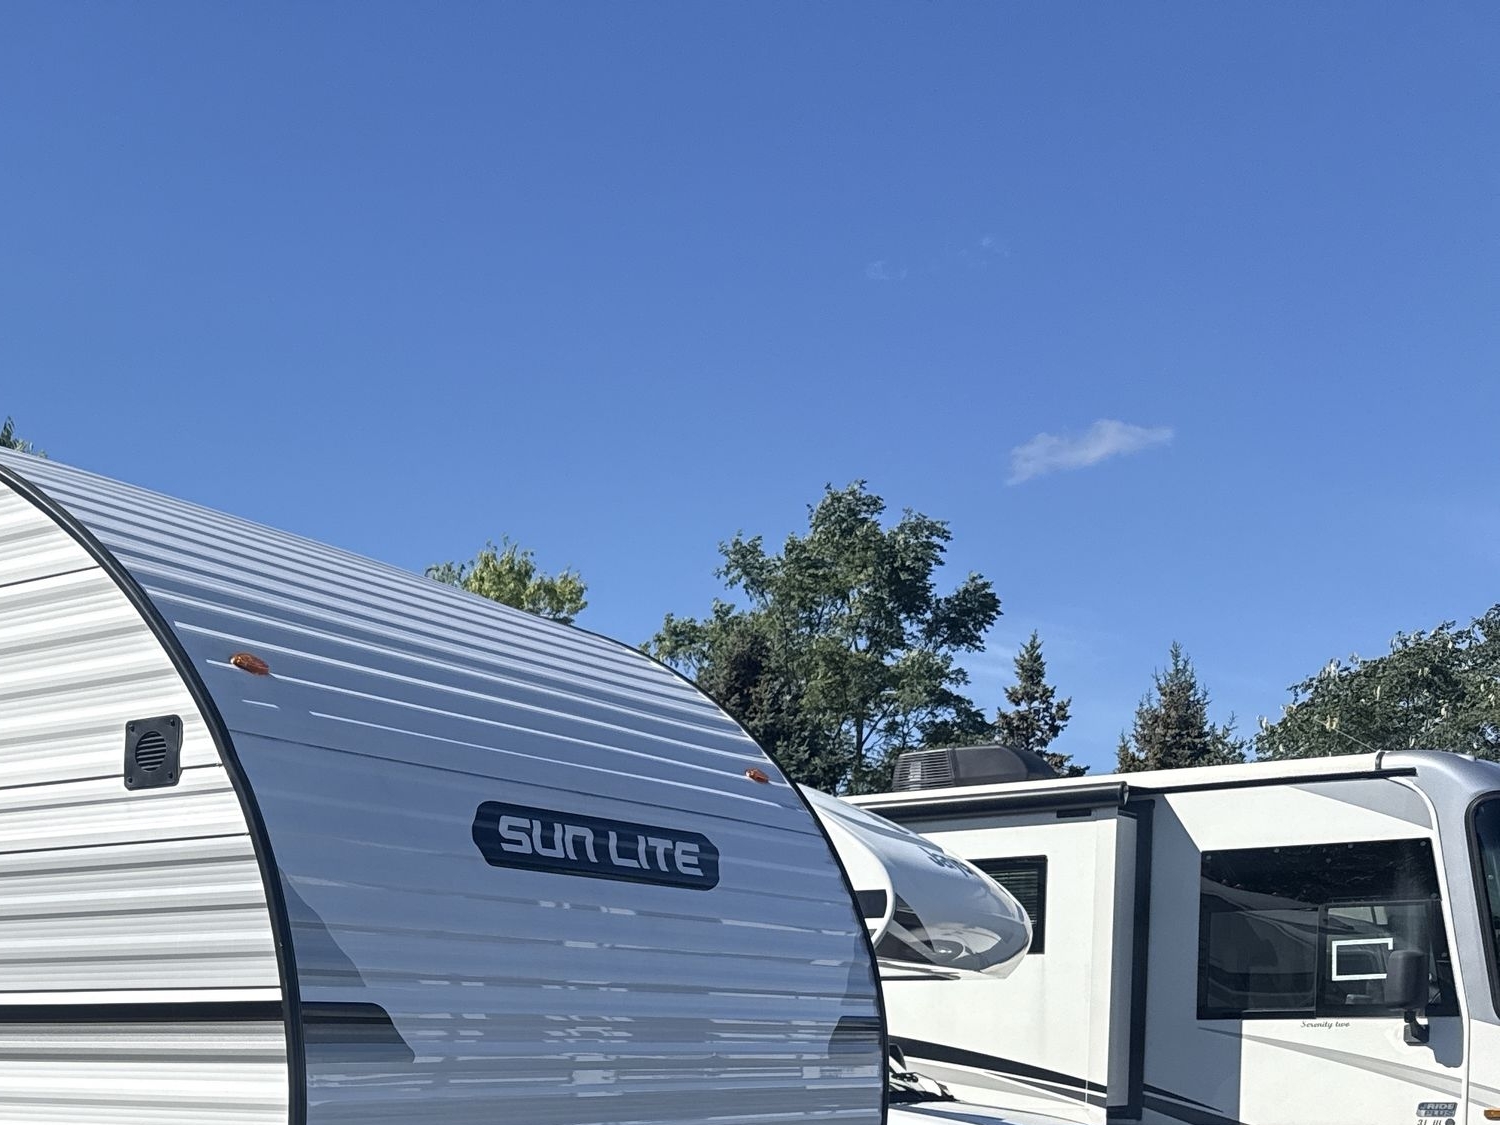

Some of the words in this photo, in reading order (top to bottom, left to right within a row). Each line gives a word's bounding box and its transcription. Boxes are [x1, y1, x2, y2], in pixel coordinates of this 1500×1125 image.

[499, 815, 599, 863] SUN
[608, 830, 704, 876] LITE
[1300, 1020, 1333, 1030] Serenity
